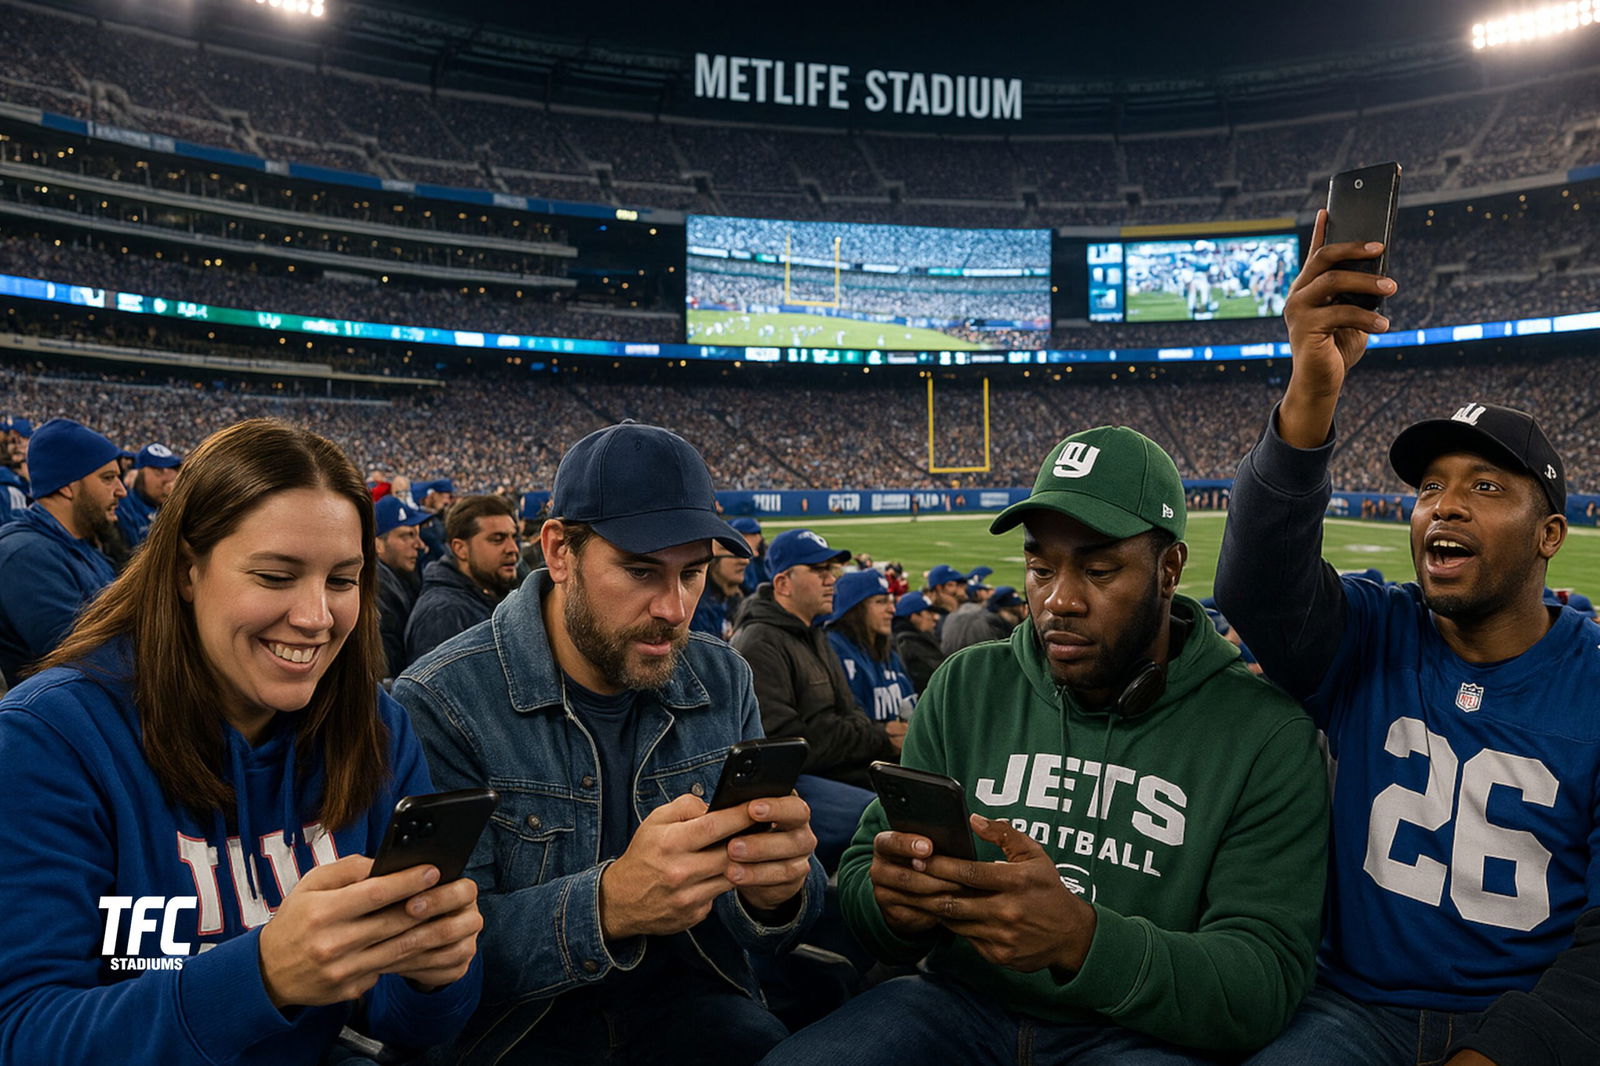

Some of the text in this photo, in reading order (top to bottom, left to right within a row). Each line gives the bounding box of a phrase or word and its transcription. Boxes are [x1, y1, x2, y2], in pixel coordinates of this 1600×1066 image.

[694, 53, 1023, 121] METLIFE STADIUM
[975, 753, 1188, 847] JETS
[1363, 716, 1560, 932] 26
[995, 818, 1162, 877] OOTBALL
